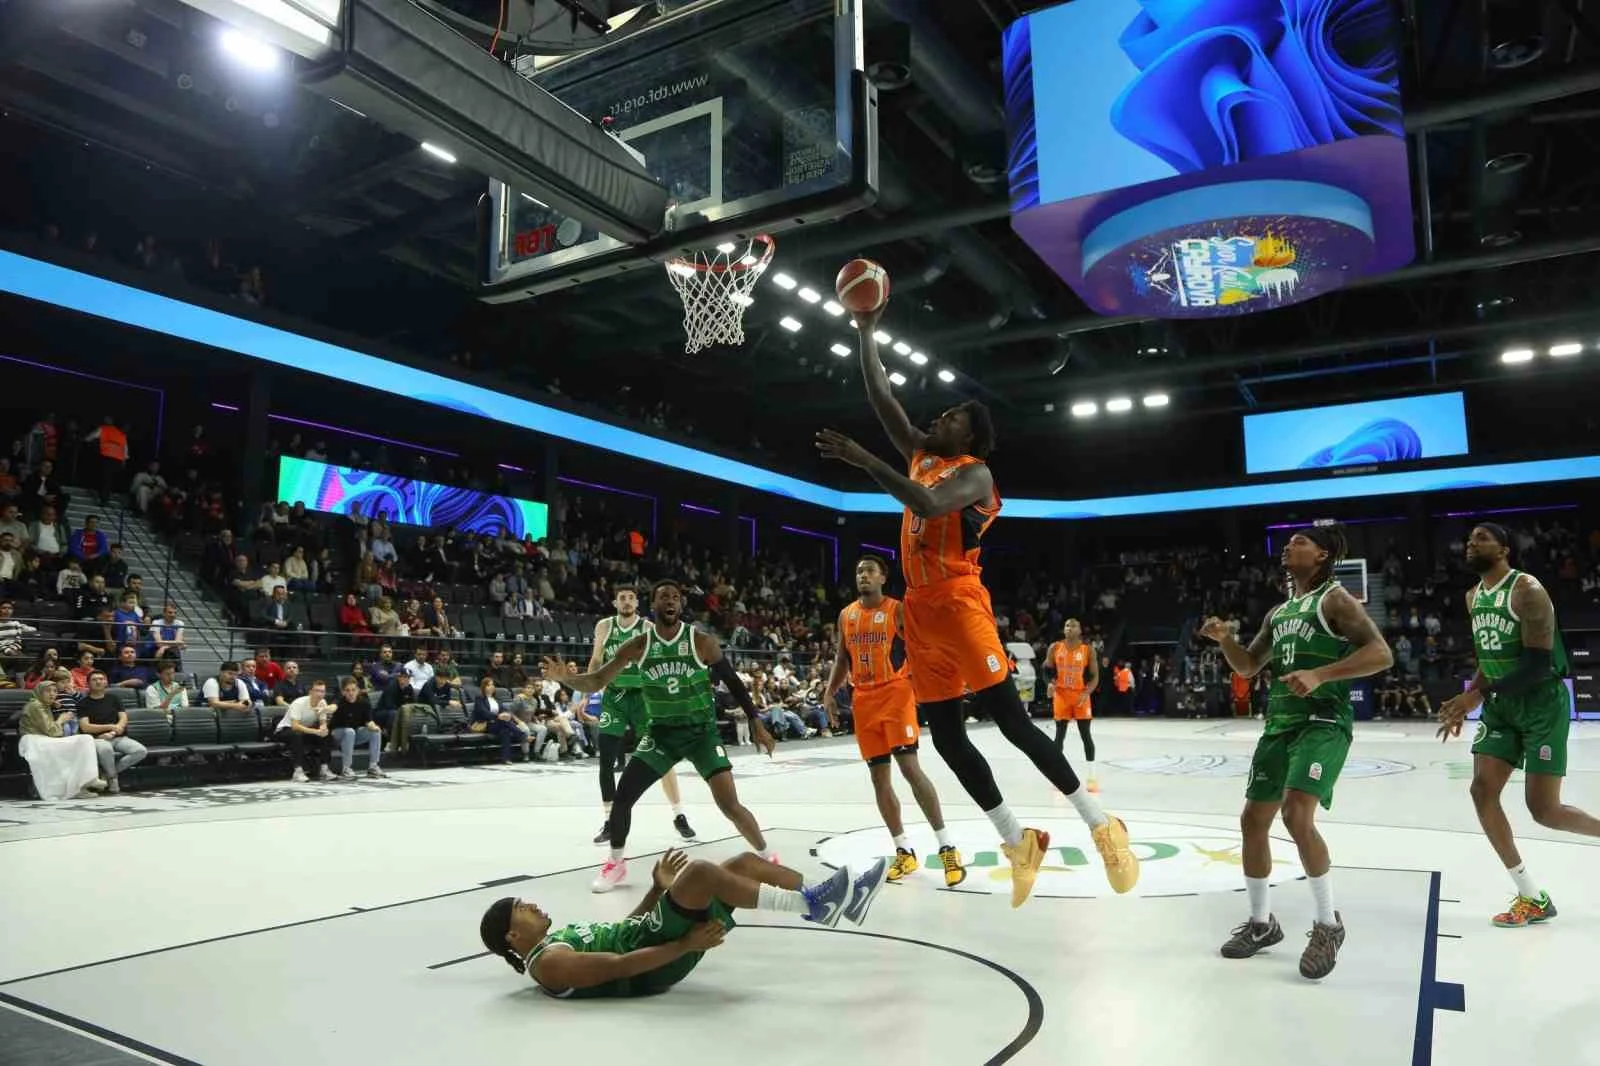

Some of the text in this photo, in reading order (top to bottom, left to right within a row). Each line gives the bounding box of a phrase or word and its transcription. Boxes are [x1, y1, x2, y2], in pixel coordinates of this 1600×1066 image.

[1479, 630, 1503, 650] 22
[1281, 642, 1296, 666] 31
[666, 676, 680, 695] 2
